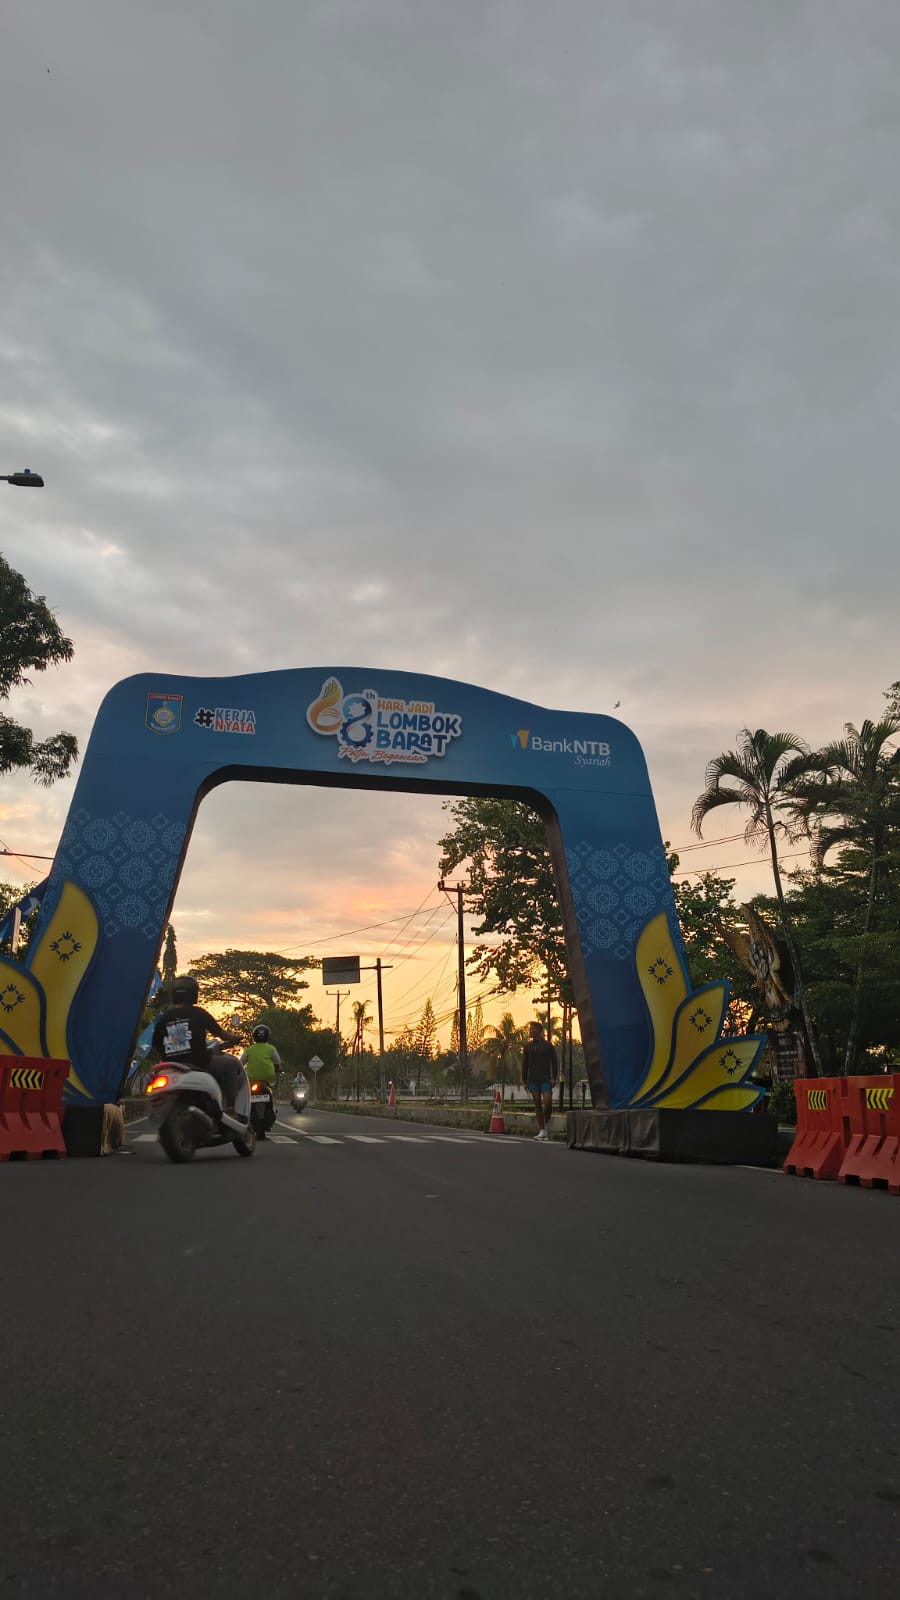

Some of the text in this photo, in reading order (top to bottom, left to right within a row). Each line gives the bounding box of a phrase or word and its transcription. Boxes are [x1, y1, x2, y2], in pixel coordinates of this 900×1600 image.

[214, 719, 254, 733] NYATA
[376, 711, 459, 735] LOMBOK
[376, 729, 448, 753] BARAT
[574, 755, 612, 768] Syariah
